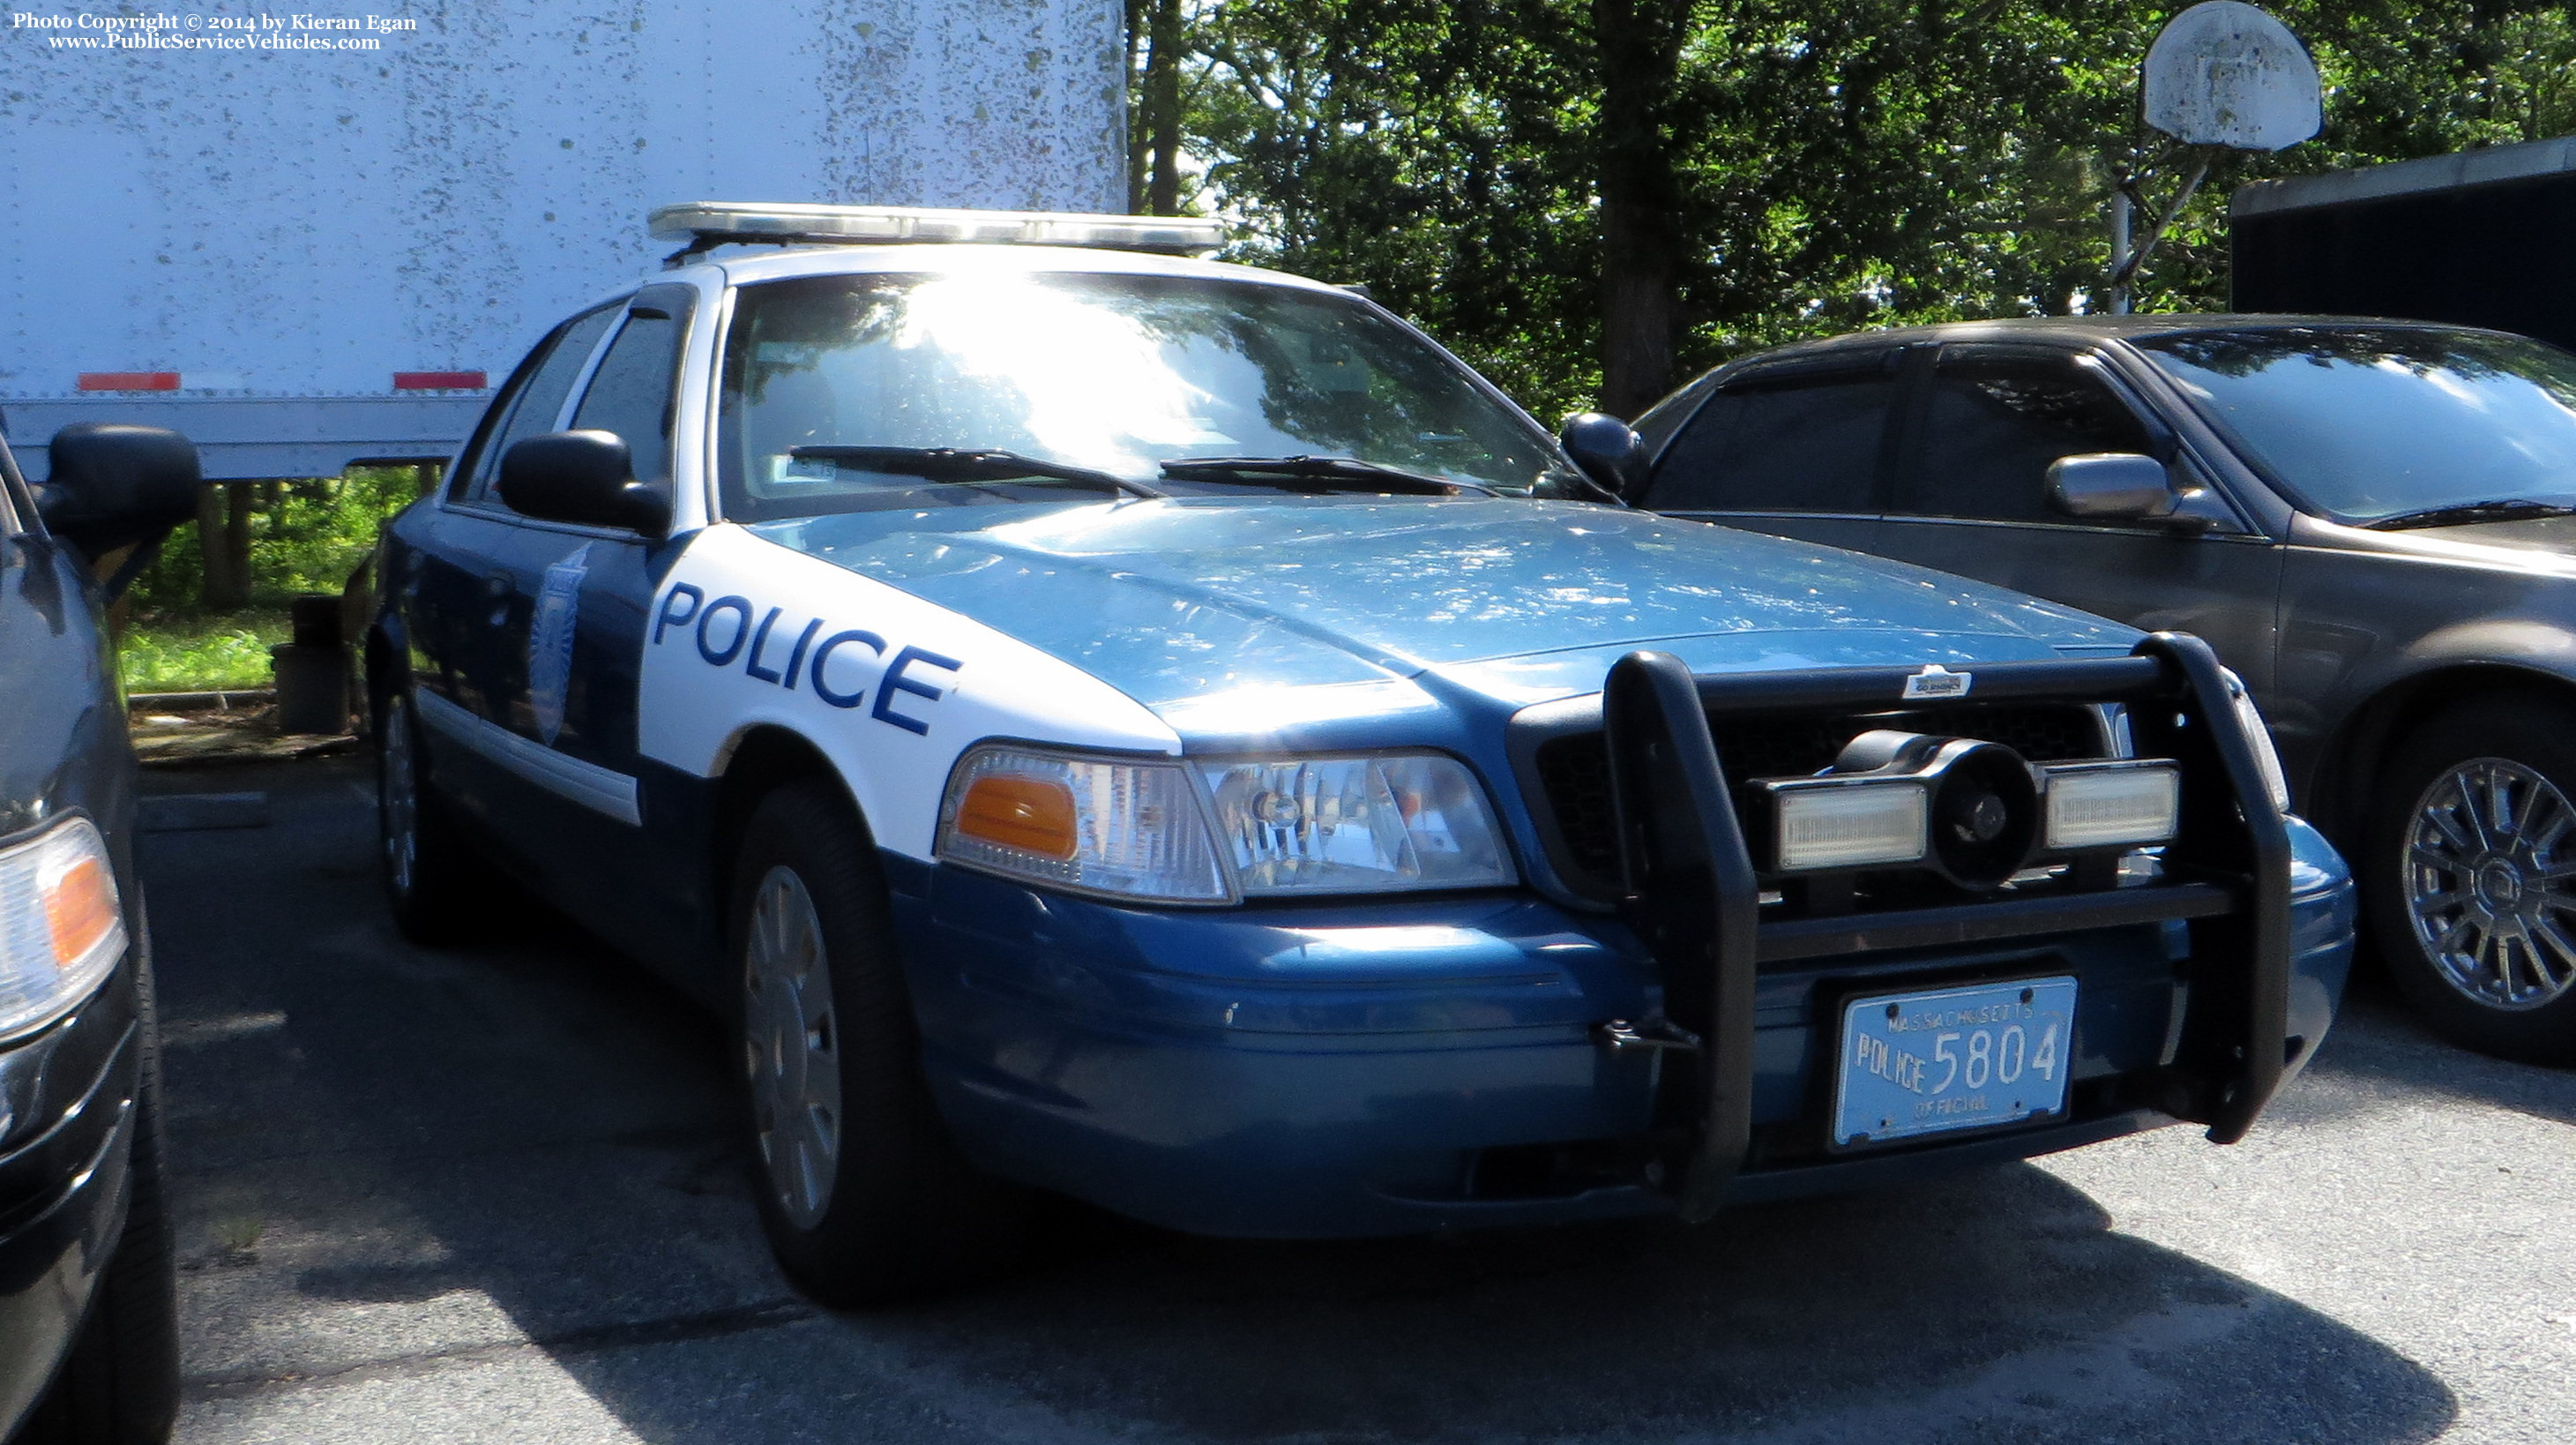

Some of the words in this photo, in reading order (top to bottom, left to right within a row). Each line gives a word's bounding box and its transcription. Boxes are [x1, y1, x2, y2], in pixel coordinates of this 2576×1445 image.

[653, 581, 964, 736] POLICE
[1887, 1002, 2034, 1032] MASSACHUSETTS
[1855, 1032, 1926, 1095] POLICE
[1931, 1024, 2058, 1096] 5804
